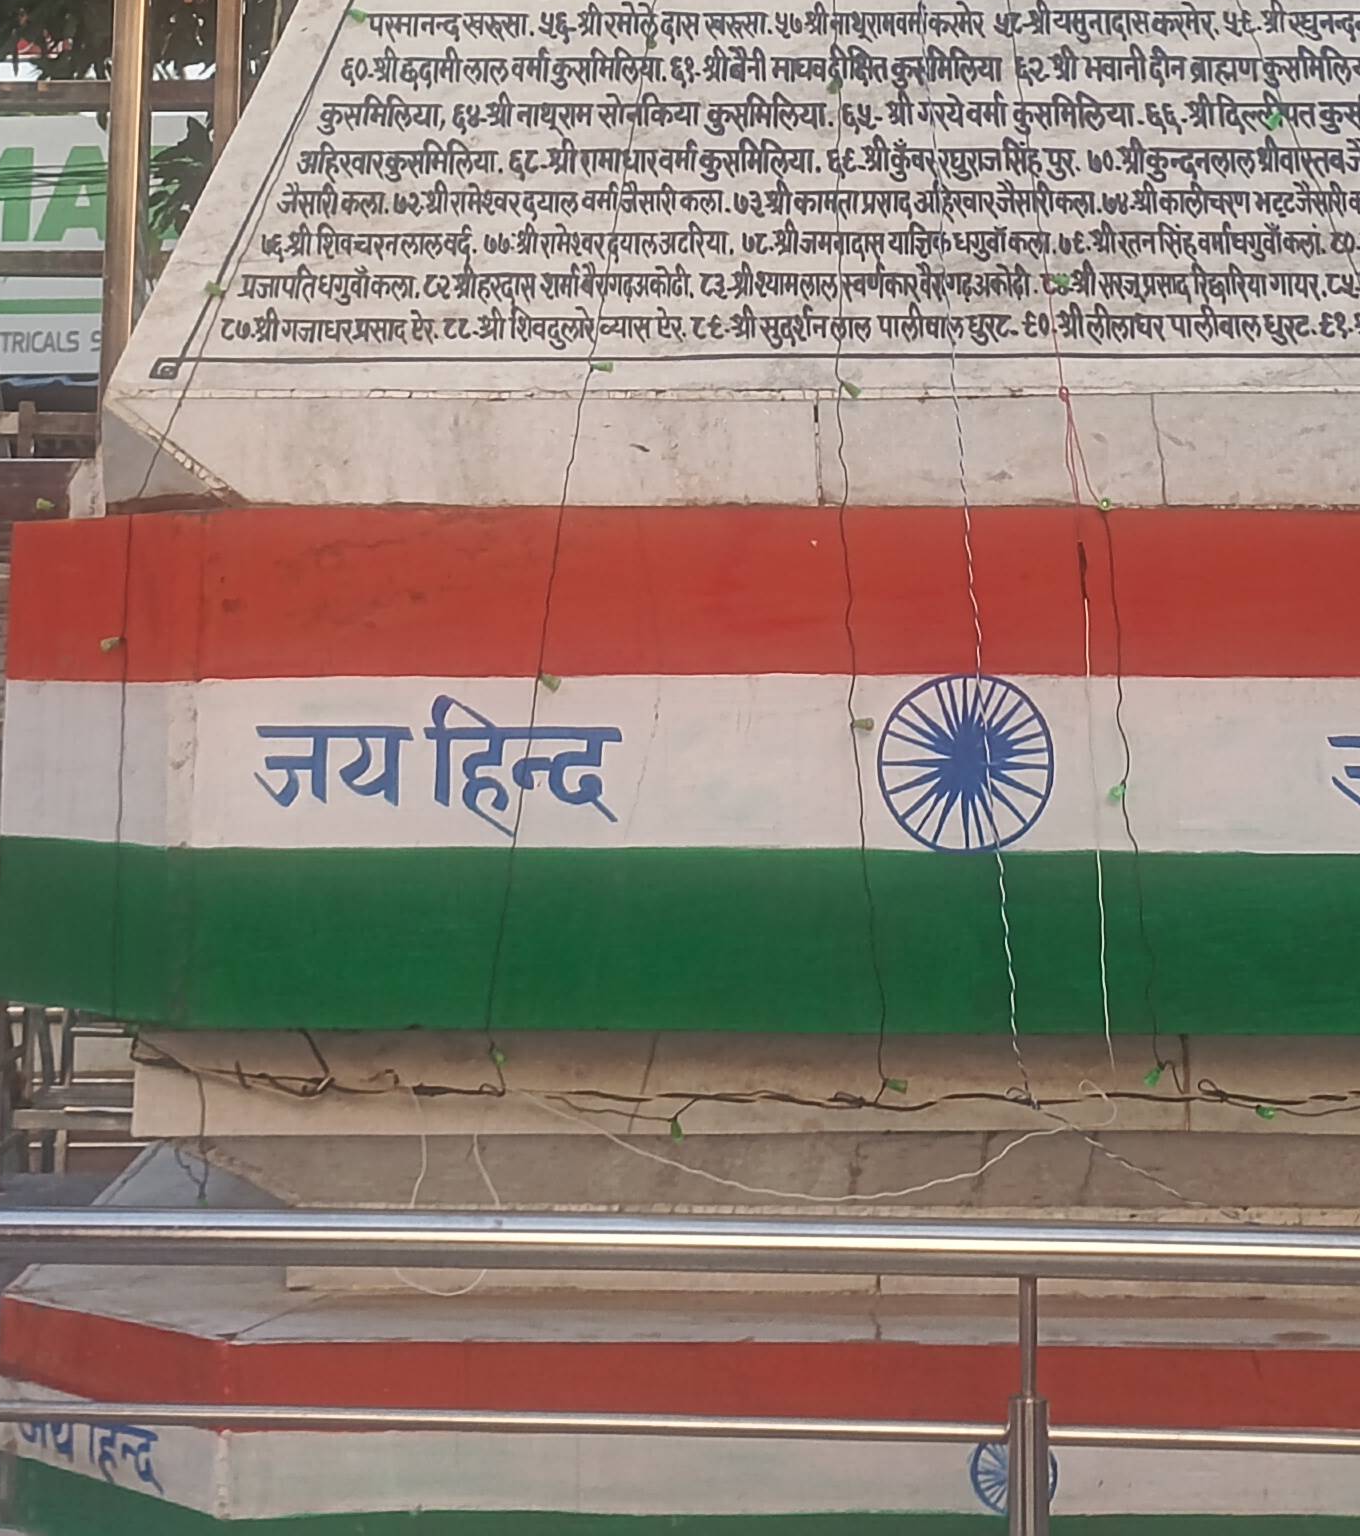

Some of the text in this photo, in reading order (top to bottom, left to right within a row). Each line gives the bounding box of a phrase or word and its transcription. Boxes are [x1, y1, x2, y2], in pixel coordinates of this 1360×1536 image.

[369, 12, 461, 43] परमानन्द
[516, 103, 594, 139] नाथूराम
[598, 94, 701, 131] सोनकिया
[599, 314, 651, 342] व्यास
[877, 303, 965, 342] पालीवाल
[1171, 305, 1262, 343] पालीवाल
[254, 695, 622, 837] जय हिन्द
